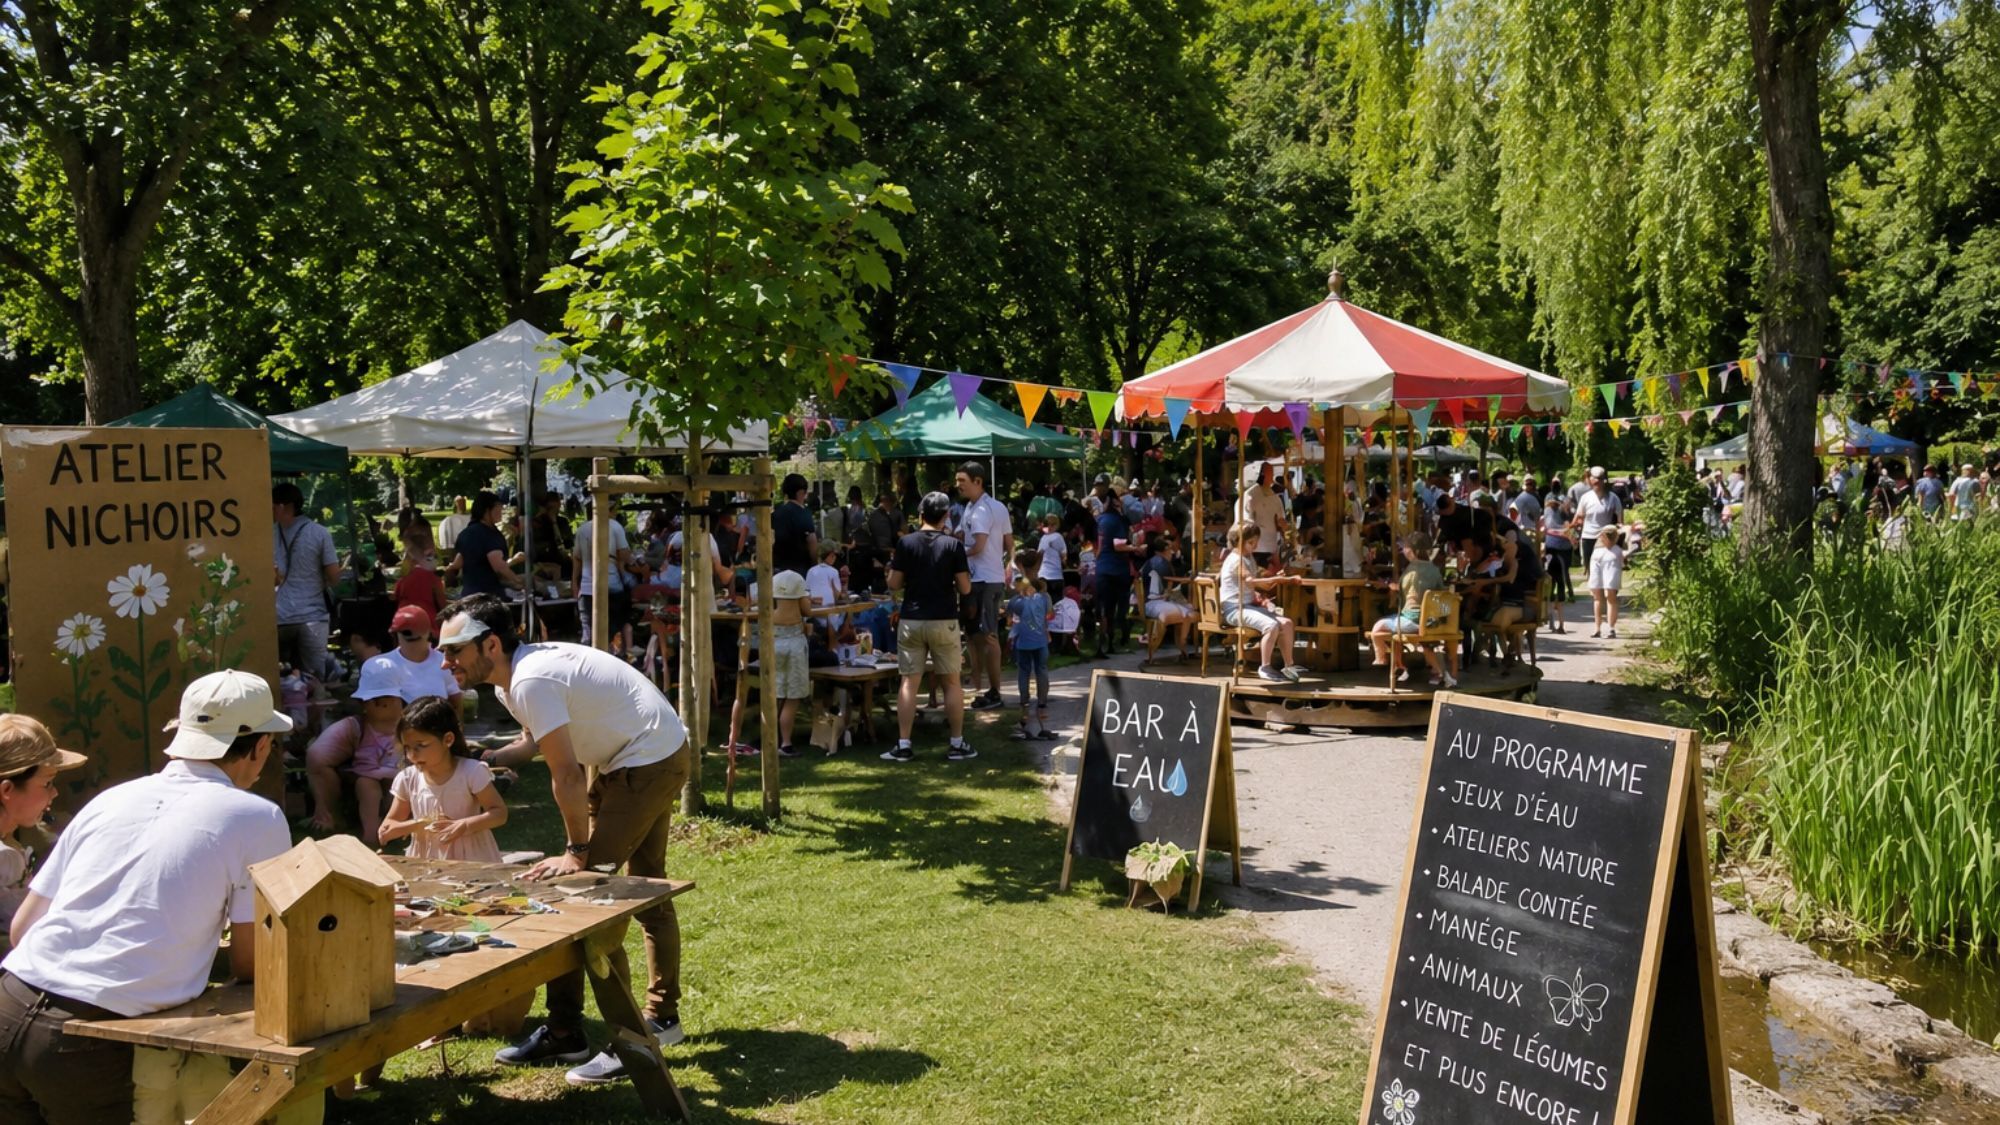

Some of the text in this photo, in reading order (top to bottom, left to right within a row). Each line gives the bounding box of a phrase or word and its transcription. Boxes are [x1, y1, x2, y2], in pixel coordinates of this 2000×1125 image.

[50, 443, 227, 485] ATELIER
[45, 499, 242, 550] NICHOIRS
[1102, 698, 1200, 744] BAR À
[1112, 753, 1179, 793] EAU
[1447, 728, 1648, 795] AU PROGRAMME
[1451, 780, 1504, 812] JEUX
[1443, 823, 1619, 886] ATELIERS NATURE
[1436, 865, 1598, 930] BALADE CONTÉE
[1429, 908, 1522, 956] MANÉGE
[1421, 952, 1524, 1007] ANIMAUX
[1403, 1043, 1430, 1072] ET
[1438, 1055, 1487, 1095] PLUS
[1414, 997, 1608, 1091] VENTE DE LÉGUMES
